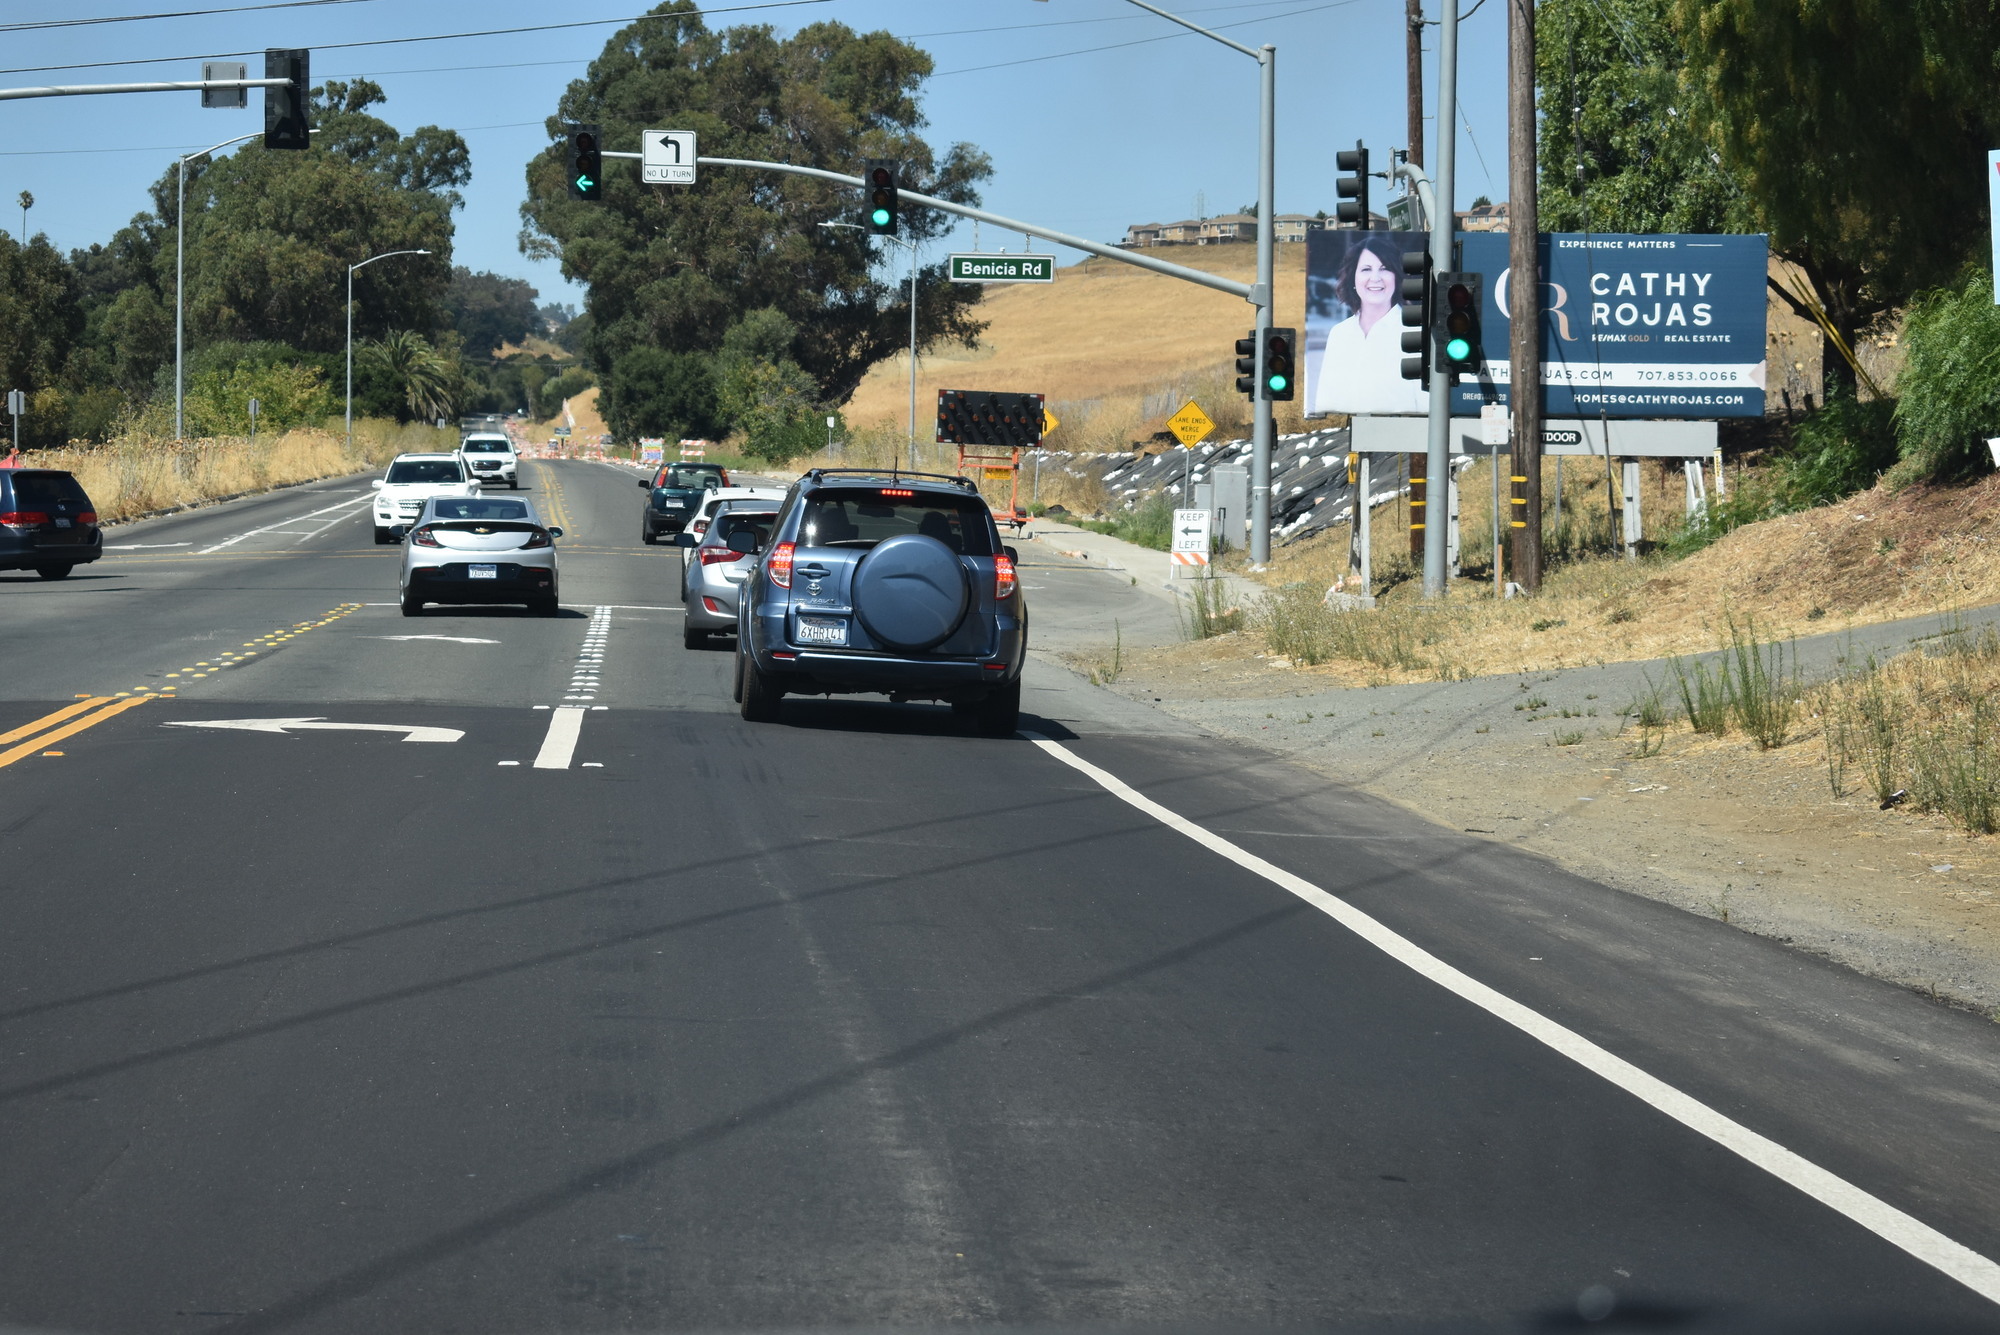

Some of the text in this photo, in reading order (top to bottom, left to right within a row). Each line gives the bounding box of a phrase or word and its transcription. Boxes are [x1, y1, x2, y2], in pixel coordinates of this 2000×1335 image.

[661, 169, 668, 178] U
[1559, 240, 1676, 249] EXPERIENCE MATTERS
[961, 261, 1042, 275] Benicia Rd
[1591, 272, 1712, 297] CATHY
[1591, 302, 1712, 326] ROJAS
[1592, 334, 1626, 342] RE/MAX
[1664, 334, 1690, 342] REAL
[1637, 370, 1738, 381] 707.853.0066
[1573, 394, 1744, 405] HOMES@CATHYROJAS.COM
[1180, 512, 1205, 521] KEEP
[1178, 541, 1202, 549] LEFT
[800, 626, 842, 640] 6XHR141
